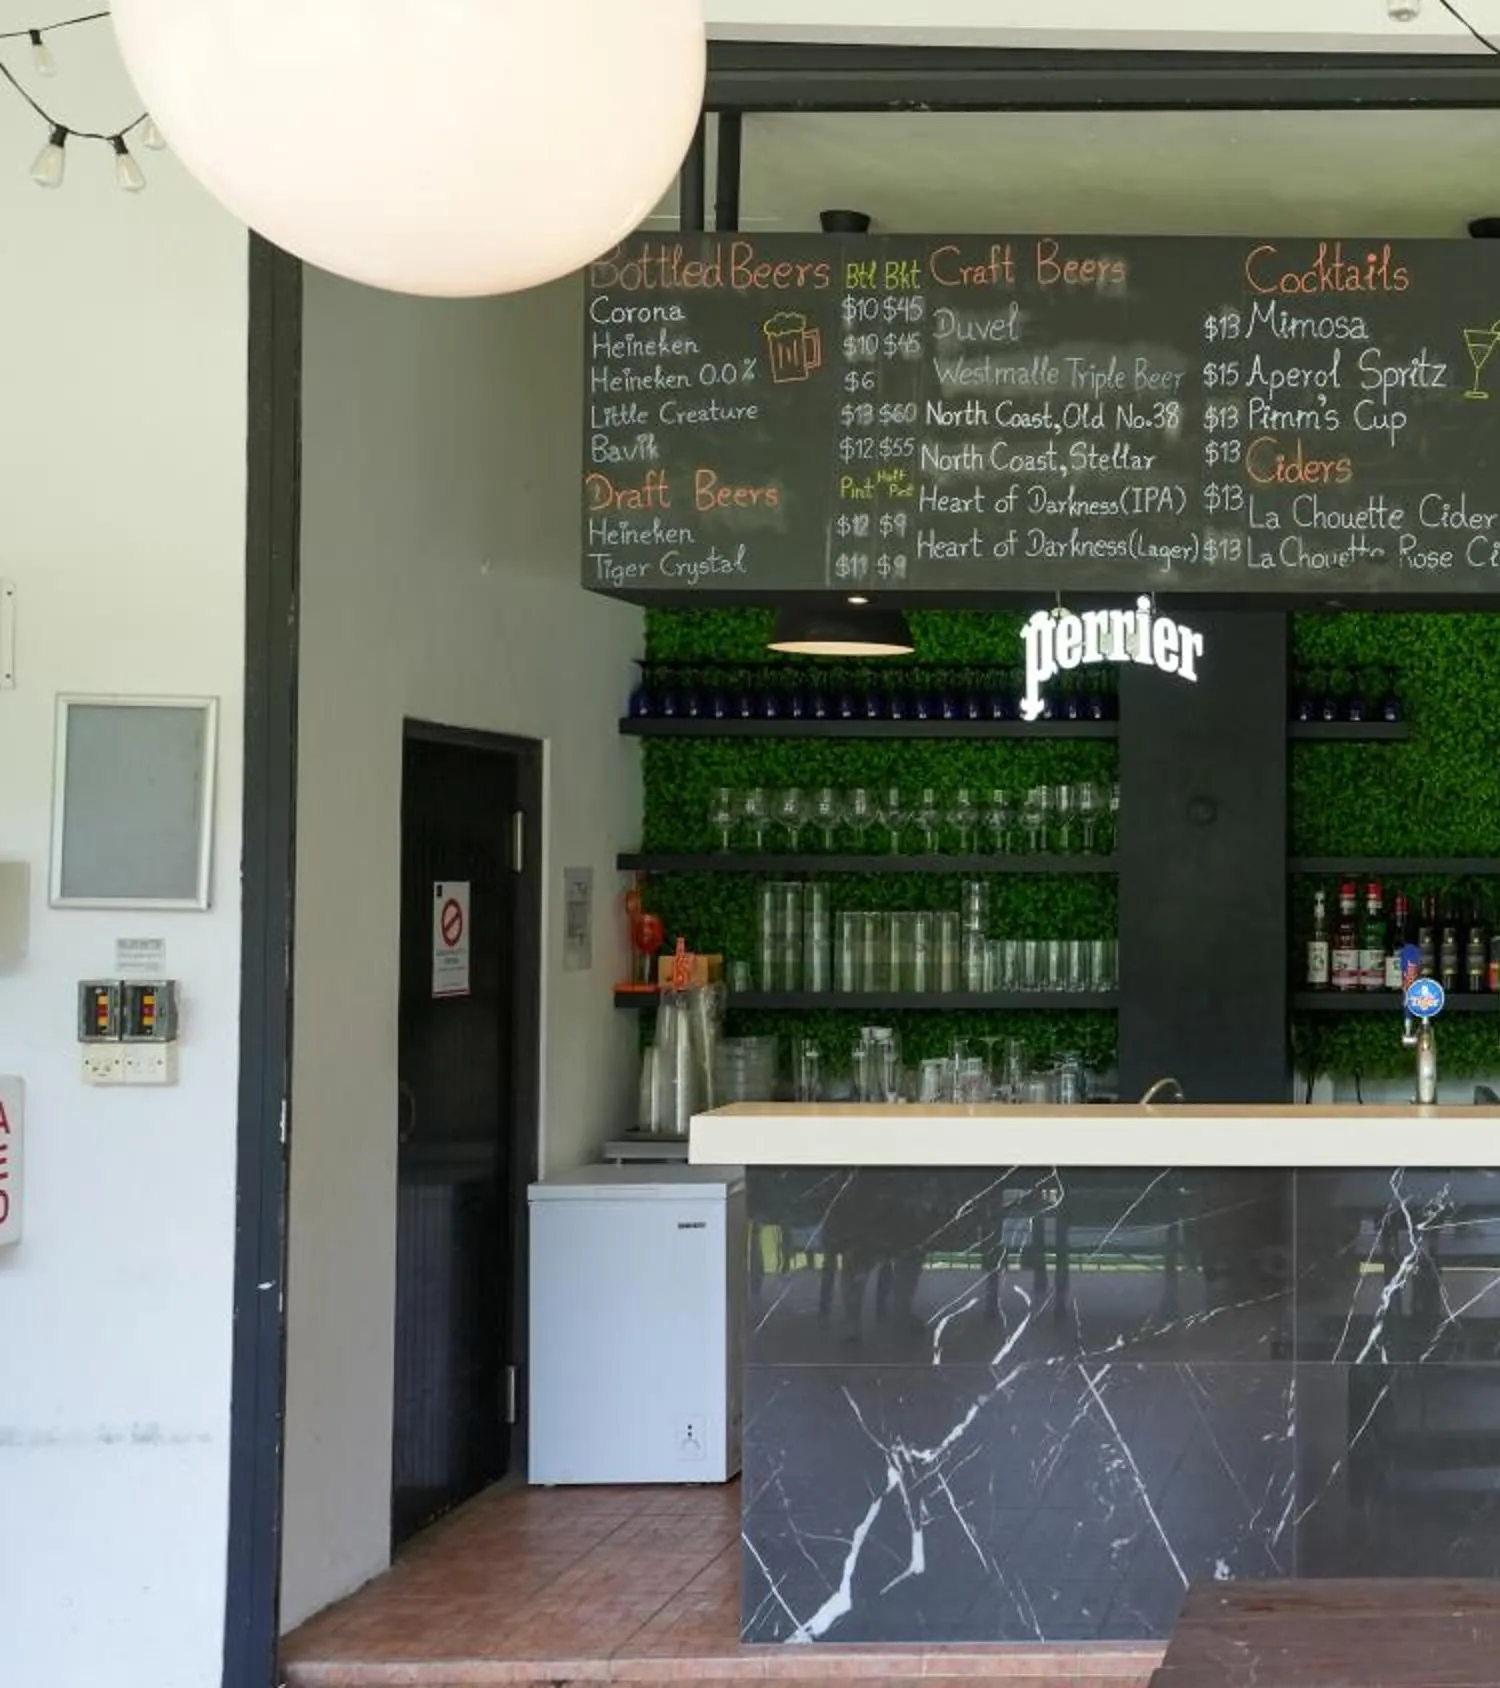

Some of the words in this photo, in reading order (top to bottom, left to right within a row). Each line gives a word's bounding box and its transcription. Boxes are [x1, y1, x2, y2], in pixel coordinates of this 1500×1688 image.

[731, 241, 831, 289] Beers
[930, 244, 1015, 289] Craft
[1036, 238, 1128, 288] Beers
[1245, 242, 1410, 294] Cocktails
[589, 296, 685, 324] Corona
[841, 294, 879, 324] $10
[883, 295, 924, 323] $45
[931, 301, 1020, 342] Duvel
[1204, 313, 1241, 343] $13
[1244, 299, 1369, 340] Mimosa
[593, 329, 700, 359] Heineken
[843, 333, 879, 359] $10
[591, 367, 692, 393] Heineken
[699, 358, 758, 386] 0.0%
[844, 371, 875, 393] $6
[932, 355, 1060, 388] Westmalle
[1064, 355, 1127, 398] Triple
[1134, 357, 1186, 395] Beer
[1203, 362, 1239, 390] $15
[1245, 348, 1341, 402] Aperol
[1358, 347, 1448, 405] Spritz
[591, 403, 648, 430] Little
[659, 401, 759, 425] Creature
[926, 402, 989, 429] North
[1203, 406, 1240, 431] $13
[1248, 394, 1340, 432] Pimm's
[1354, 399, 1408, 447] Cup
[591, 433, 660, 463] Bavik
[839, 435, 874, 462] $12
[879, 436, 915, 460] $55
[920, 440, 984, 472] North
[1205, 439, 1241, 467] $13
[1245, 436, 1353, 484] Ciders
[585, 470, 671, 511] Draft
[694, 470, 780, 511] Beers
[841, 475, 875, 499] Pint
[918, 484, 985, 513] Heart
[995, 484, 1019, 513] of
[1203, 482, 1244, 514] $13
[589, 517, 695, 545] Heineken
[879, 512, 907, 538] $9
[1249, 495, 1281, 530] La
[1293, 494, 1404, 530] Chouette
[1419, 492, 1499, 530] Cider
[586, 552, 650, 588] Tiger
[659, 543, 748, 586] Crystal
[917, 527, 984, 560] Heart
[993, 528, 1019, 559] of
[1203, 537, 1241, 565] $13
[1247, 536, 1277, 569] La
[1020, 594, 1204, 721] perrier
